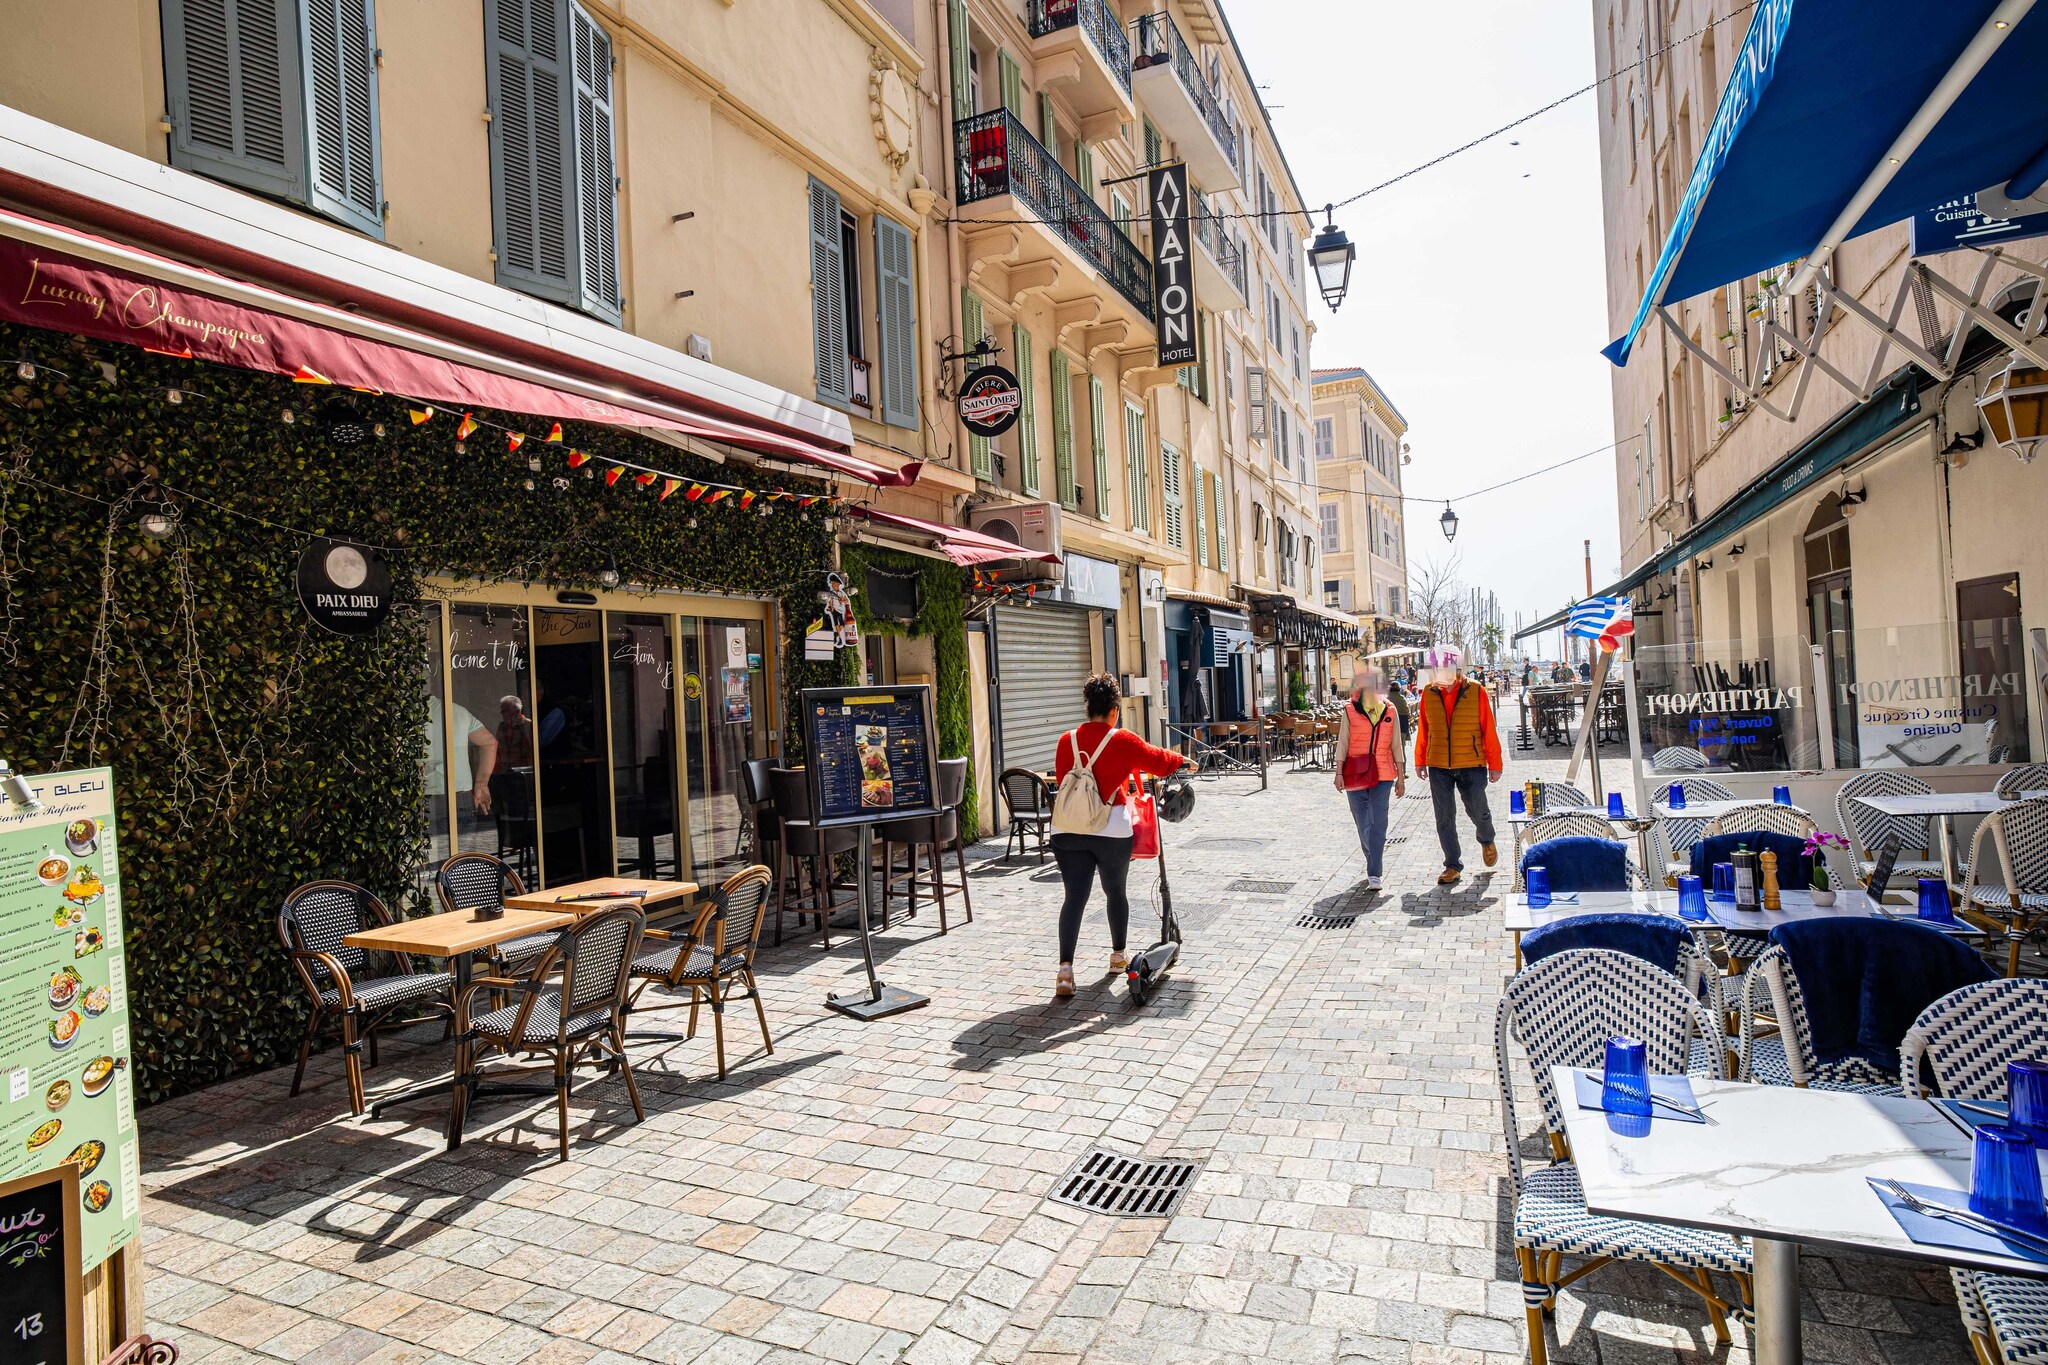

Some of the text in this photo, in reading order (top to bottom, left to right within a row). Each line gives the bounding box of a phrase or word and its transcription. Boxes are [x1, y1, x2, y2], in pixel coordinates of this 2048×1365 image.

[1156, 171, 1188, 345] AVATON
[20, 257, 266, 349] Luxury Champagnes
[1161, 348, 1195, 362] HOTEL
[316, 593, 379, 608] PAIX DIEU
[613, 642, 656, 666] Stars
[54, 780, 104, 796] BLEU
[14, 1312, 44, 1340] 13
